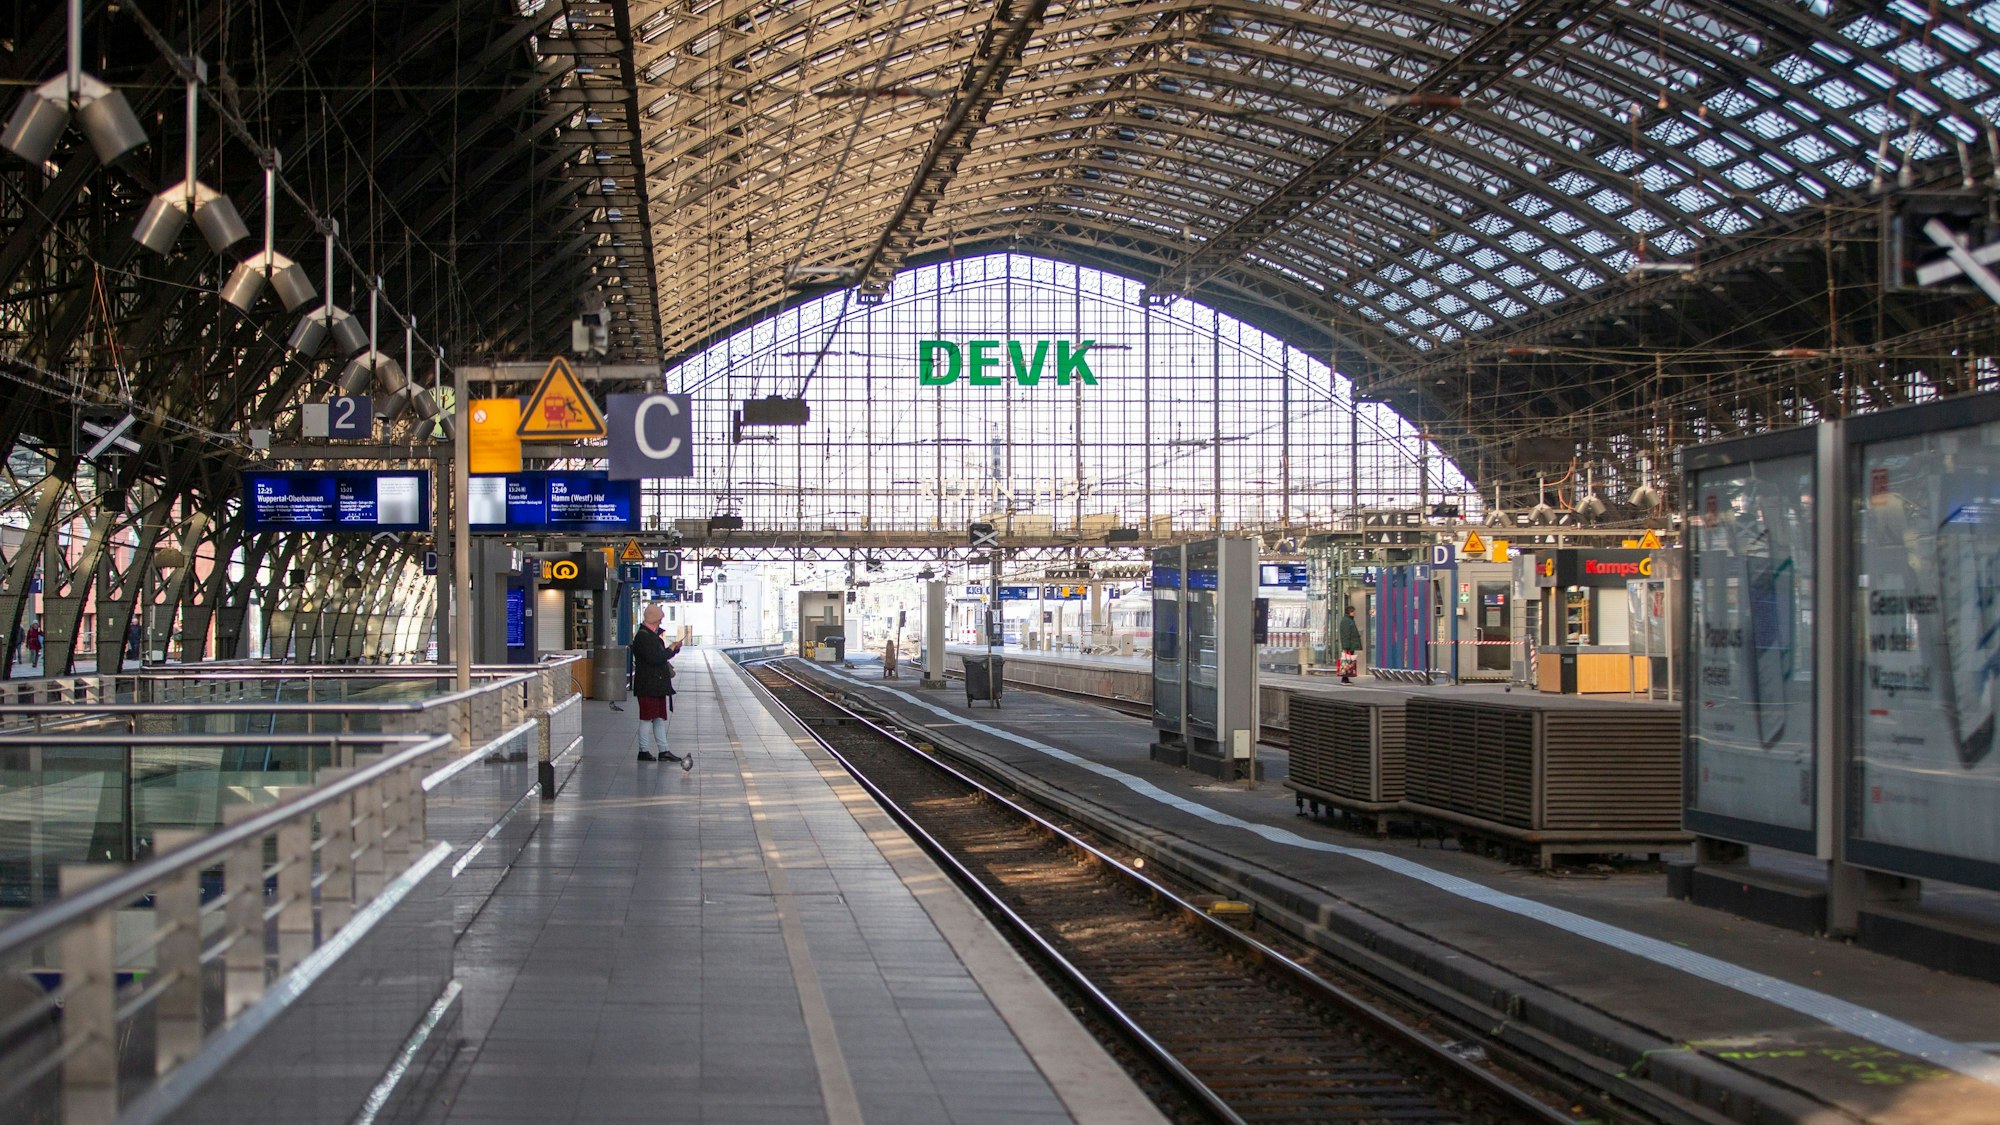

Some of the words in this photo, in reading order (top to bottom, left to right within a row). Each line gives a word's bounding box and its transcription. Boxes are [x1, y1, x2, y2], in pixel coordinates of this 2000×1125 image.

[919, 340, 1099, 386] DEVK
[335, 397, 356, 429] 2
[634, 395, 681, 459] C
[257, 487, 273, 495] 12:25
[551, 494, 570, 502] Hamm
[570, 494, 593, 503] (Westf)
[594, 494, 605, 502] Hbf
[552, 486, 568, 494] 12:49
[425, 551, 438, 571] D
[665, 553, 679, 571] D
[1433, 545, 1449, 565] D
[1585, 559, 1639, 577] Kamps
[676, 579, 683, 591] E
[1044, 587, 1051, 597] F
